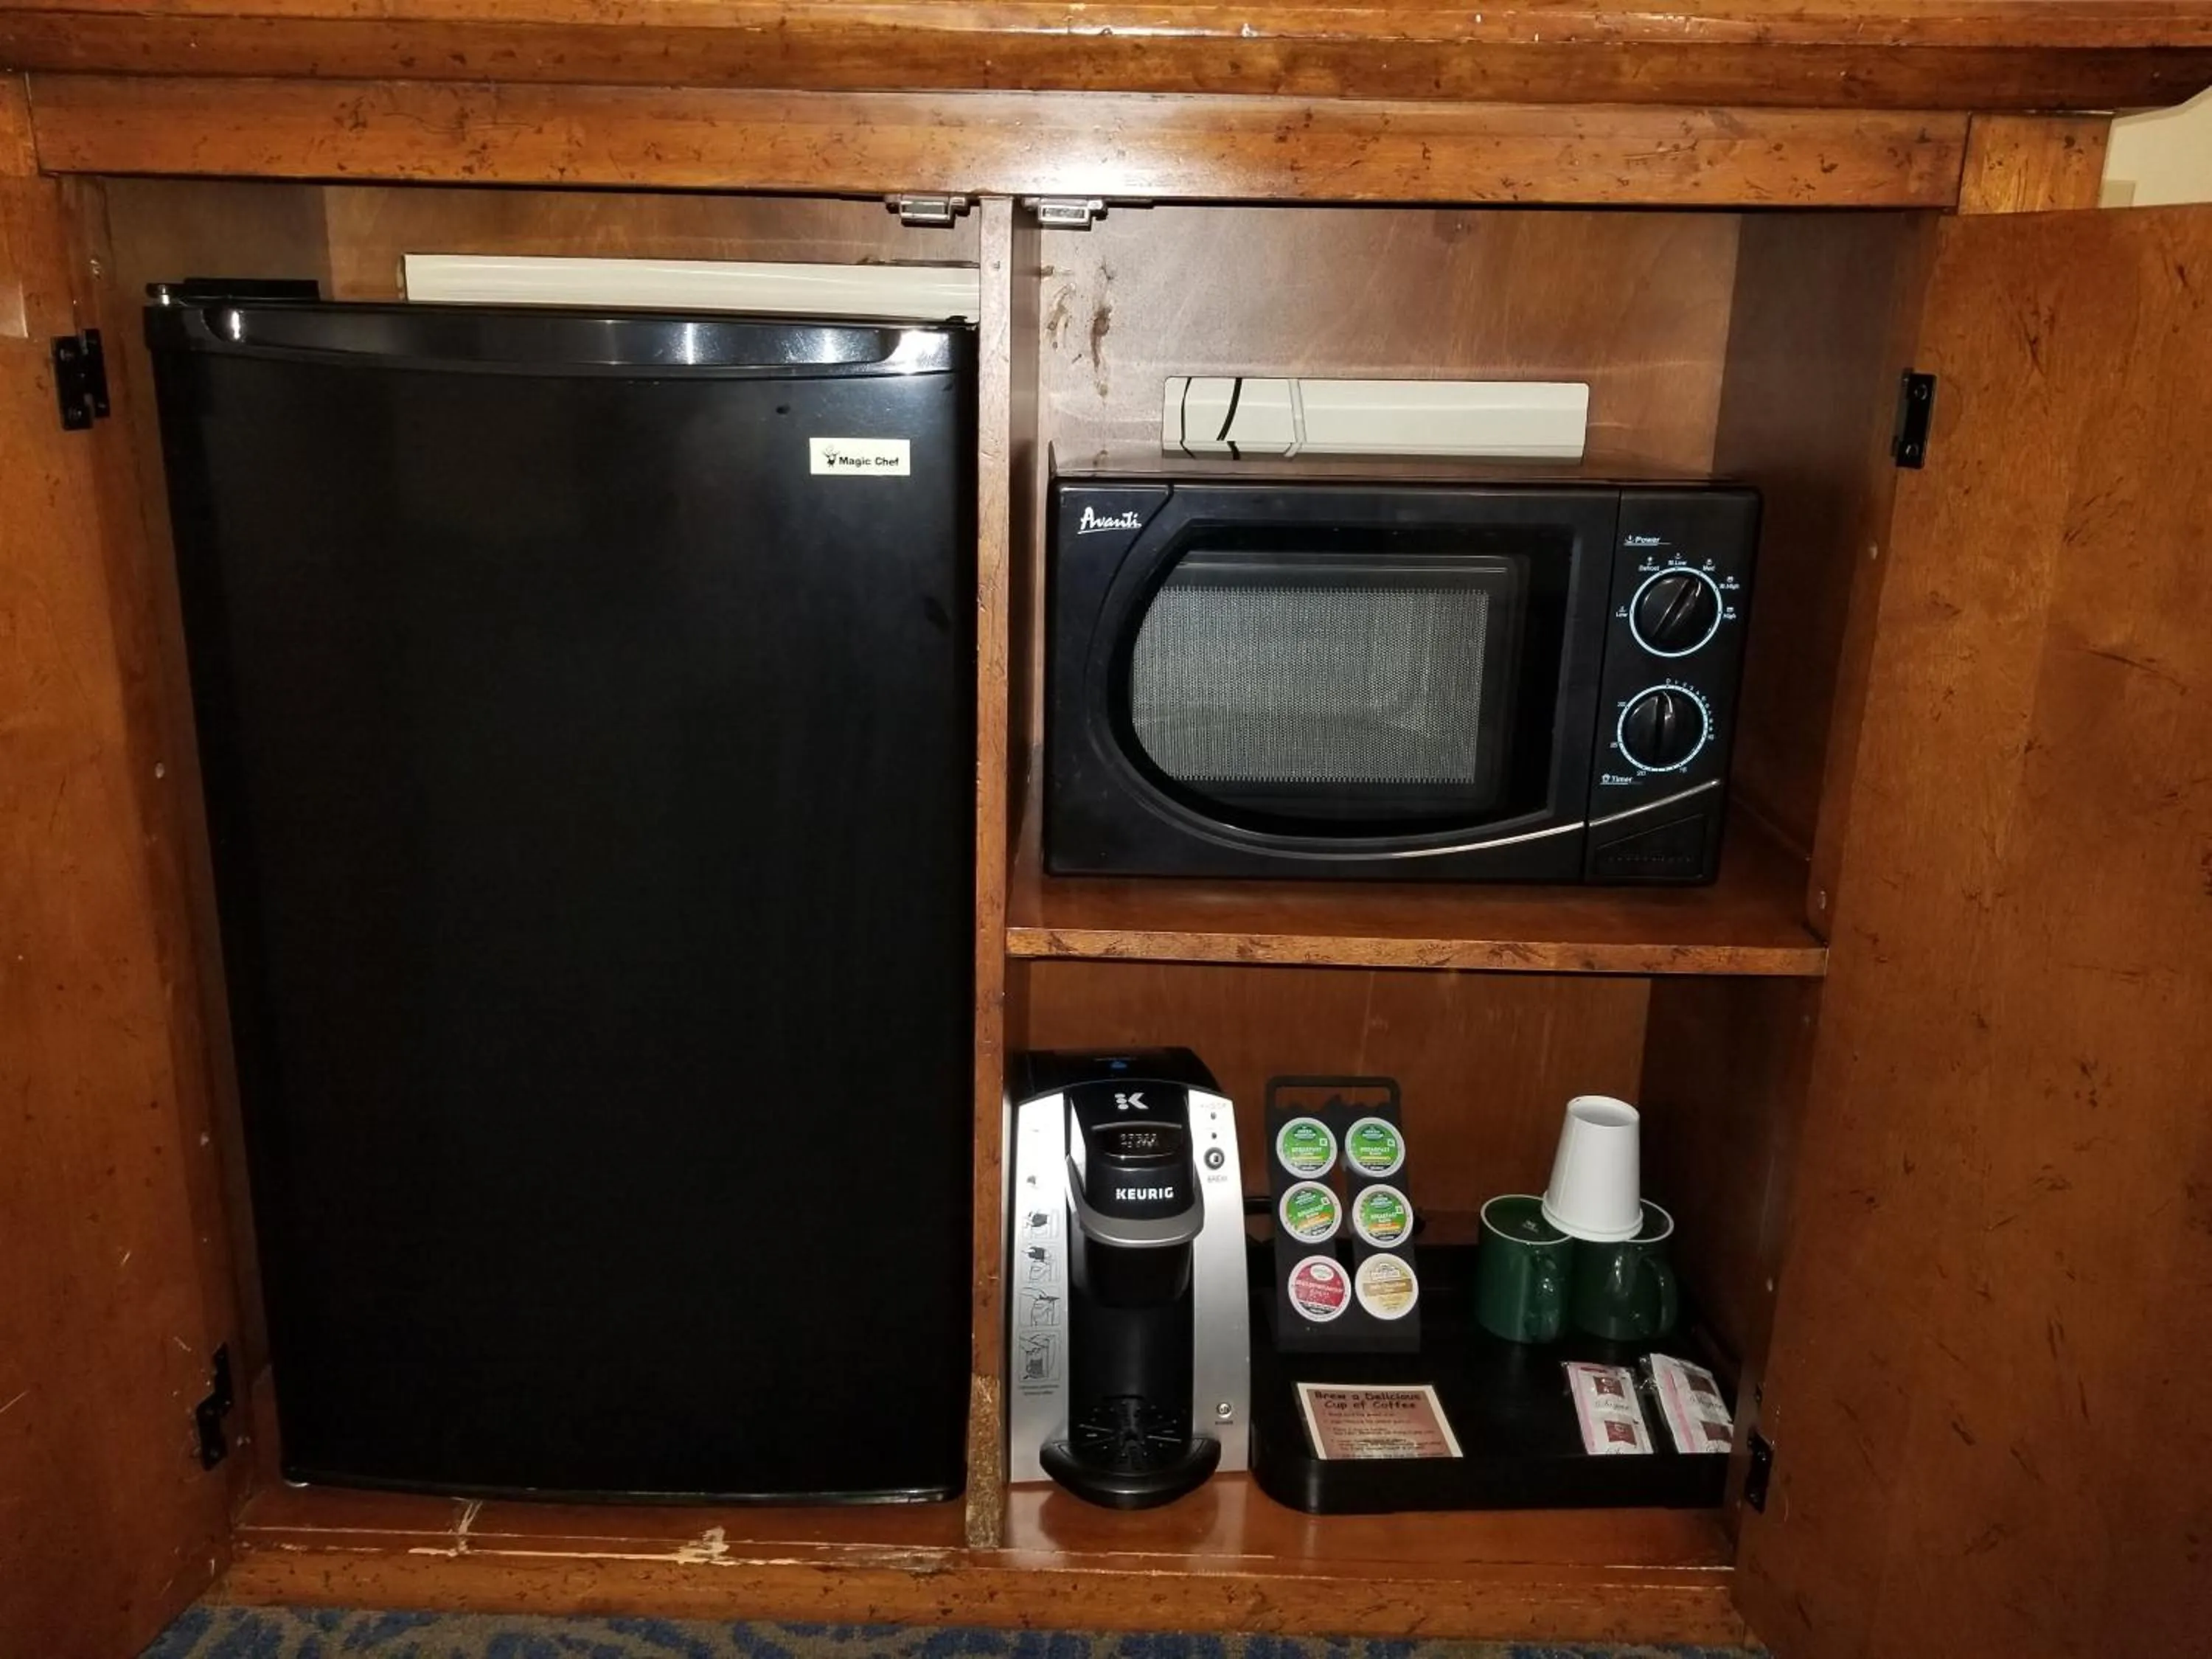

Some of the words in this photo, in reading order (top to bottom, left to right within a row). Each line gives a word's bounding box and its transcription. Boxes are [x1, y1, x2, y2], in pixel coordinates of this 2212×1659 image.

[839, 456, 871, 467] Magic
[874, 457, 899, 466] Chef
[1079, 507, 1142, 530] Avanti
[1116, 1186, 1174, 1200] KEURIG
[1365, 1392, 1422, 1400] Delicious
[1324, 1401, 1347, 1410] Cup
[1353, 1400, 1366, 1409] of
[1372, 1401, 1416, 1410] Coffee
